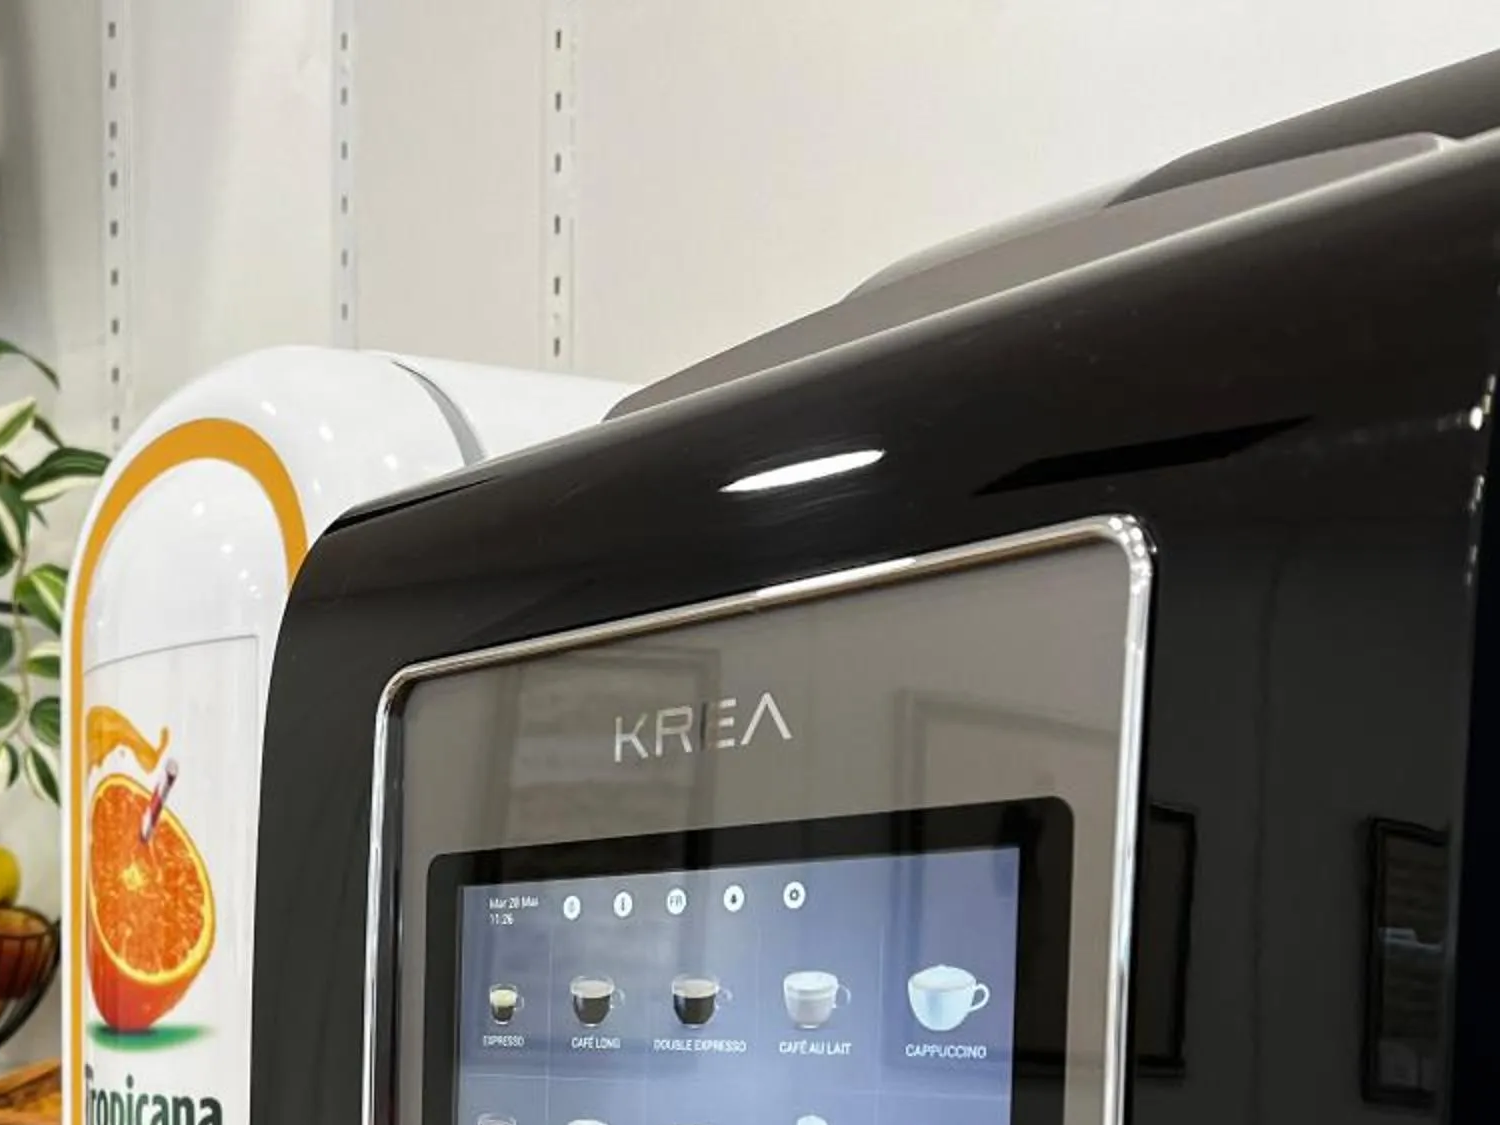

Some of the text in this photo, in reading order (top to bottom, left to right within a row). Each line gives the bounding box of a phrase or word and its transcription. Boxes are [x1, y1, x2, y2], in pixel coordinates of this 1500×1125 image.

[613, 692, 792, 763] KREA
[596, 1038, 621, 1049] LONG
[653, 1038, 692, 1051] DOUBLE
[809, 1041, 825, 1054] AU
[827, 1041, 852, 1055] LAIT
[905, 1043, 988, 1059] CAPPUCCINO
